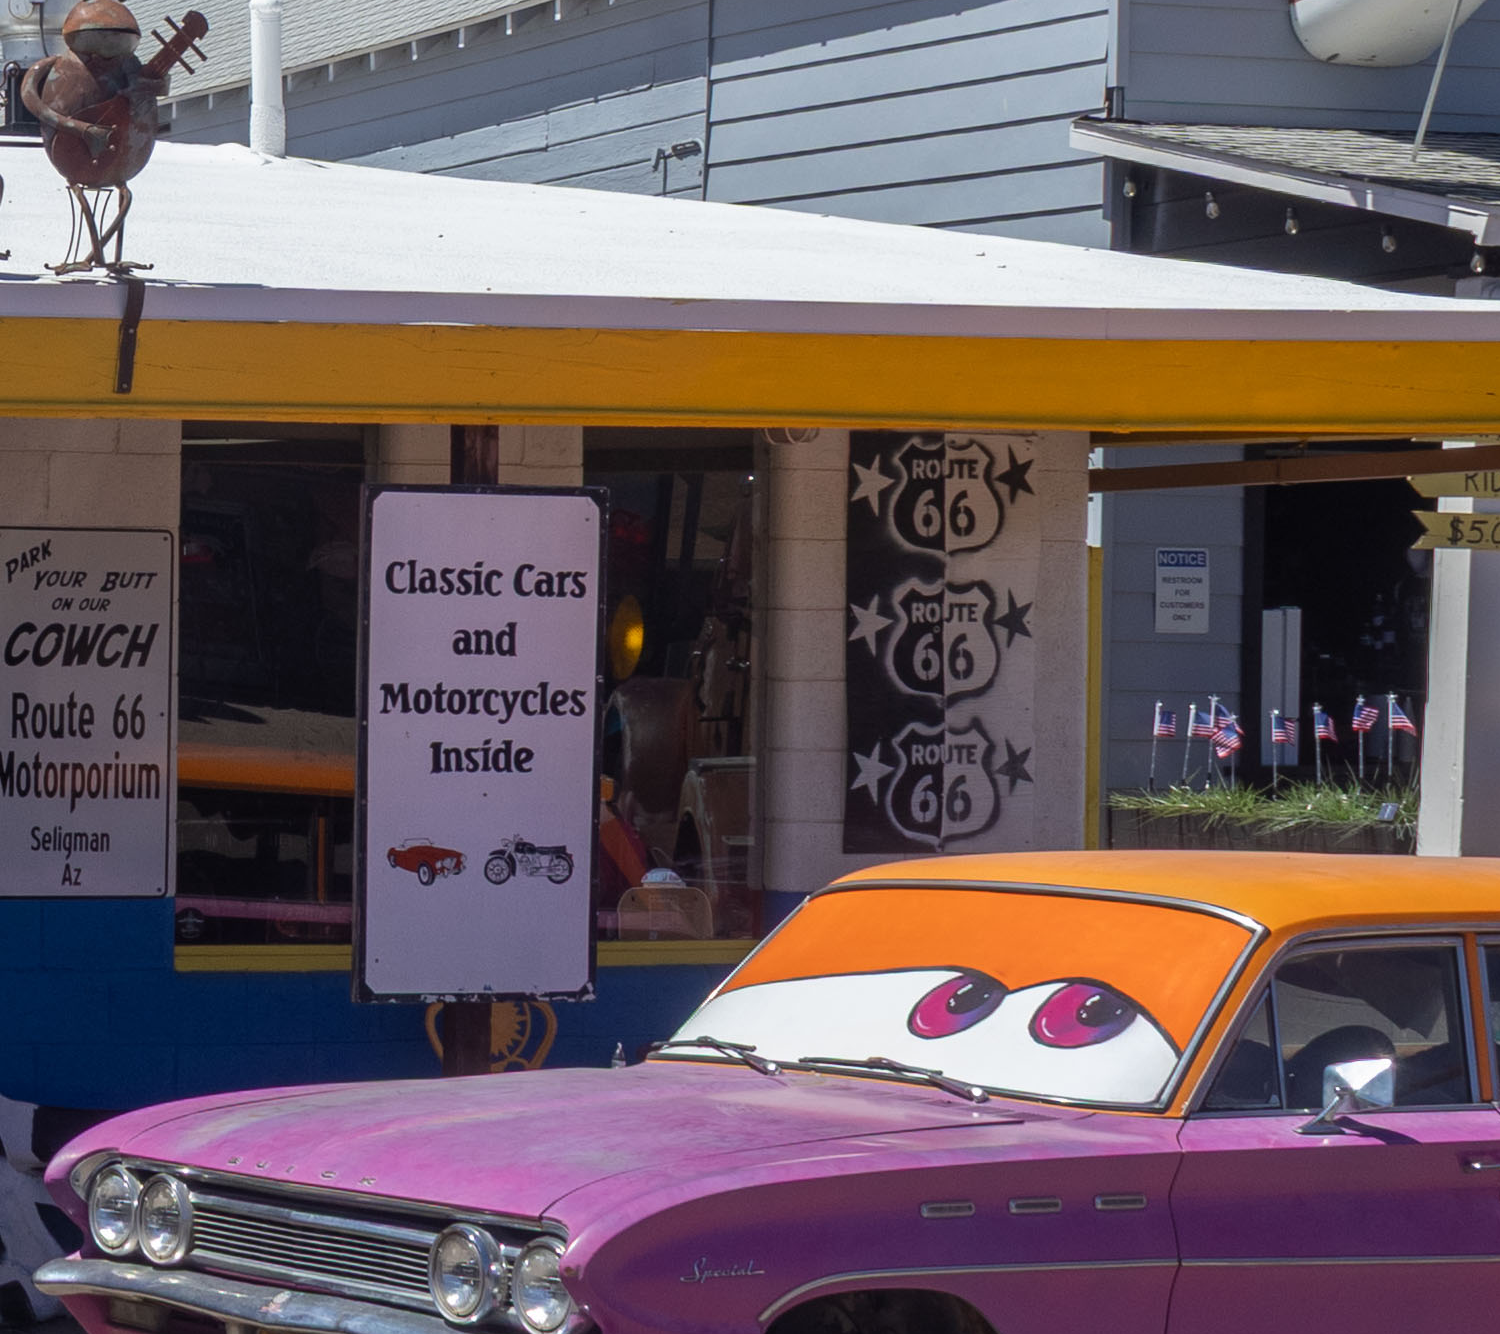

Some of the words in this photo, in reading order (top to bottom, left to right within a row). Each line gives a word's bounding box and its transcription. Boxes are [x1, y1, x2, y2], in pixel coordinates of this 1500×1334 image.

[912, 459, 978, 480] ROUTE
[913, 489, 976, 538] 66
[5, 539, 52, 584] PARK
[1159, 552, 1206, 565] NOTICE
[34, 570, 87, 591] YOUR
[100, 571, 157, 592] BUTT
[385, 559, 503, 597] Classic
[513, 563, 588, 598] Cars
[52, 597, 74, 611] ON
[79, 597, 111, 612] OUR
[911, 602, 978, 623] ROUTE
[4, 622, 159, 669] COWCH
[452, 622, 517, 656] and
[913, 632, 975, 681] 66
[11, 690, 95, 739] Route
[113, 693, 146, 740] 66
[379, 682, 588, 724] Motorcycles
[429, 738, 535, 774] Inside
[911, 744, 978, 765] ROUTE
[911, 774, 972, 823] 66
[30, 826, 110, 860] Seligman
[61, 863, 82, 886] Az
[227, 1156, 378, 1186] BUICK
[680, 1255, 766, 1284] Special
